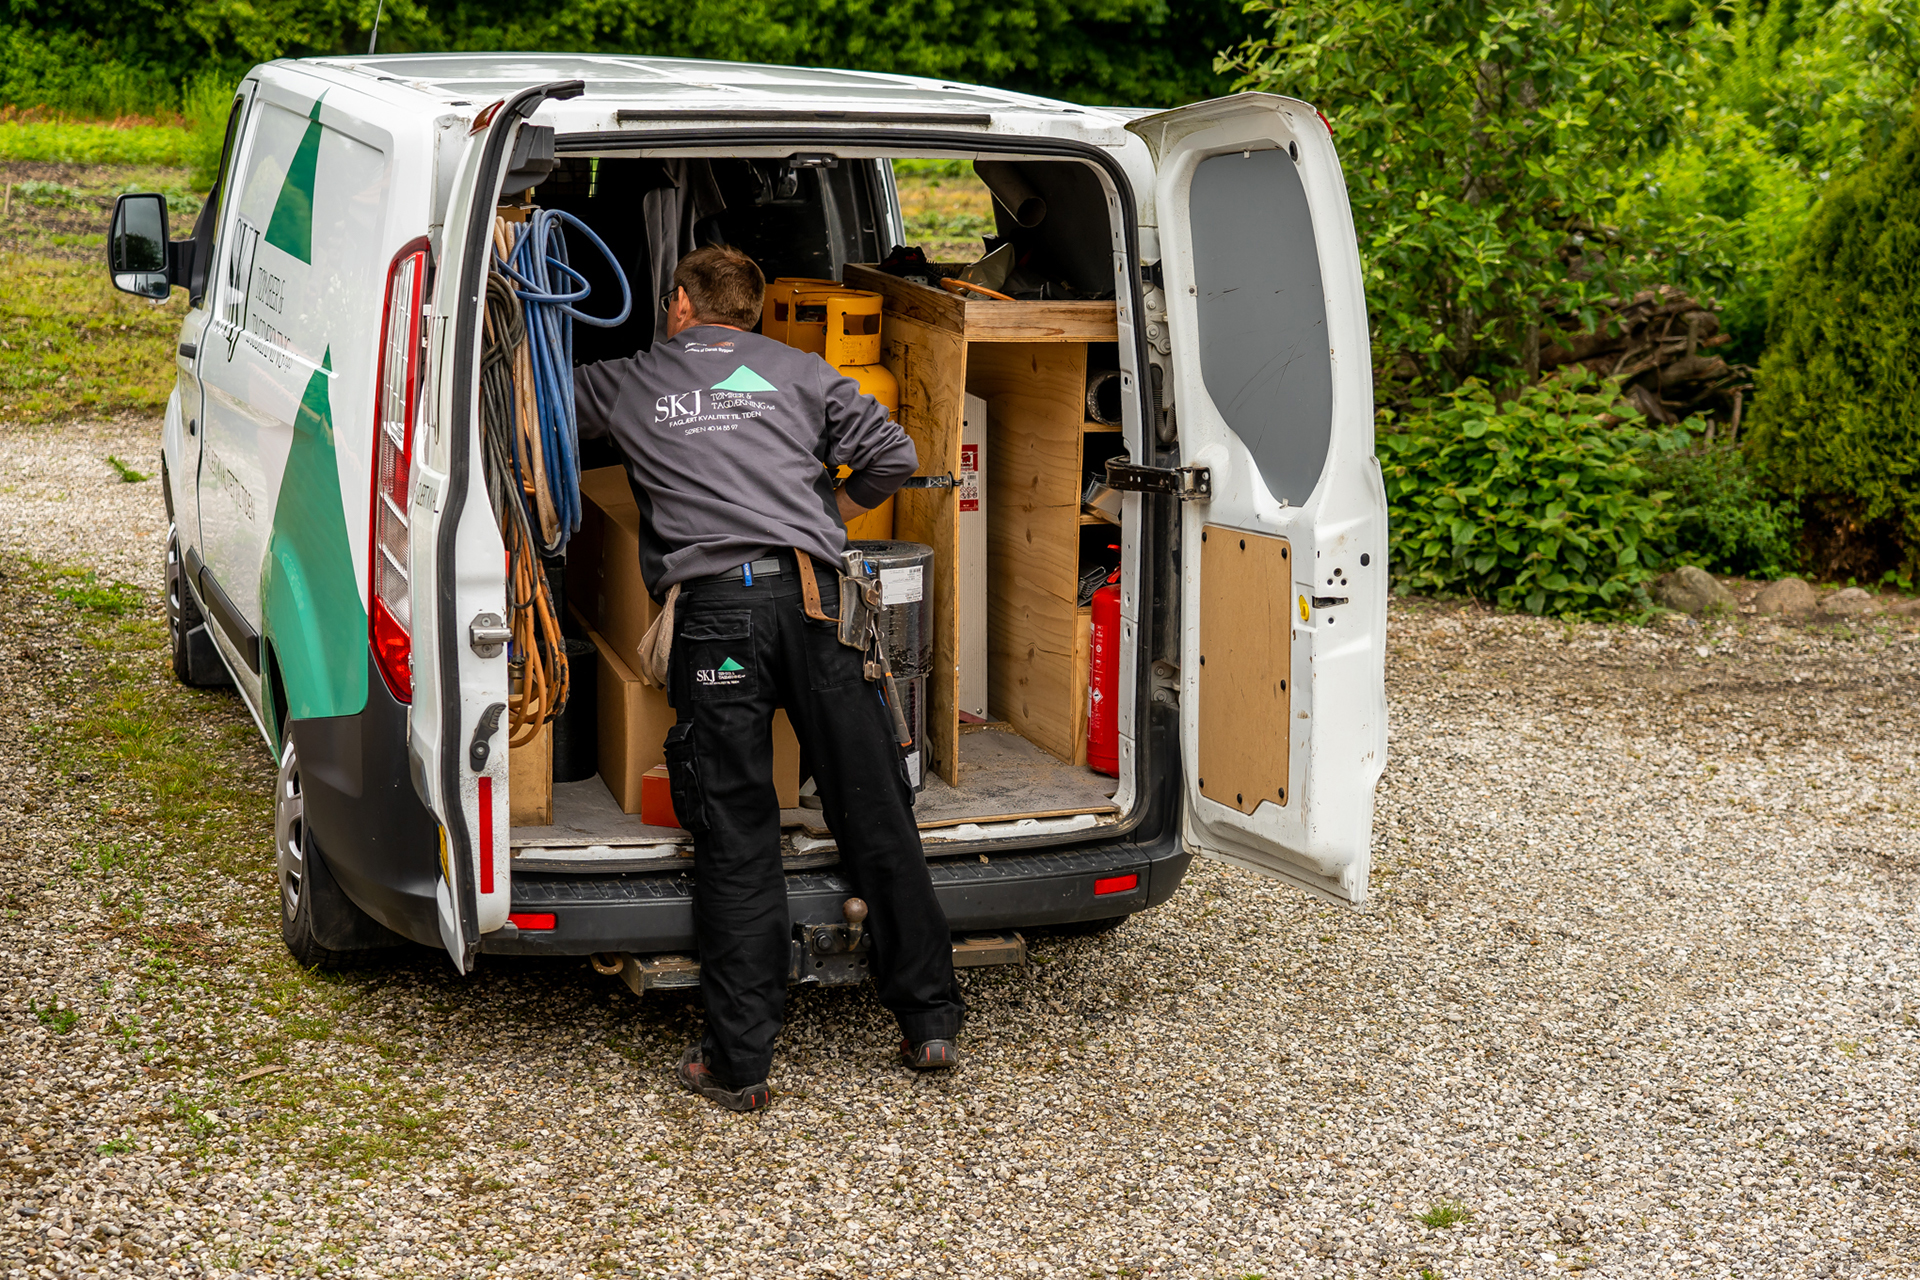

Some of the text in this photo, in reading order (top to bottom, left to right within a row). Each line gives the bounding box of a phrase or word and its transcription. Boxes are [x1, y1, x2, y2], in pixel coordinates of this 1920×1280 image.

[710, 392, 752, 401] TØMRER &
[655, 389, 702, 423] SKJ
[711, 398, 766, 410] TAGDÆKNING
[669, 416, 698, 428] FAGLÆRT
[698, 413, 730, 422] KVALITET
[742, 410, 762, 419] TIDEN
[684, 426, 707, 436] SØREN
[696, 669, 715, 683] SKJ
